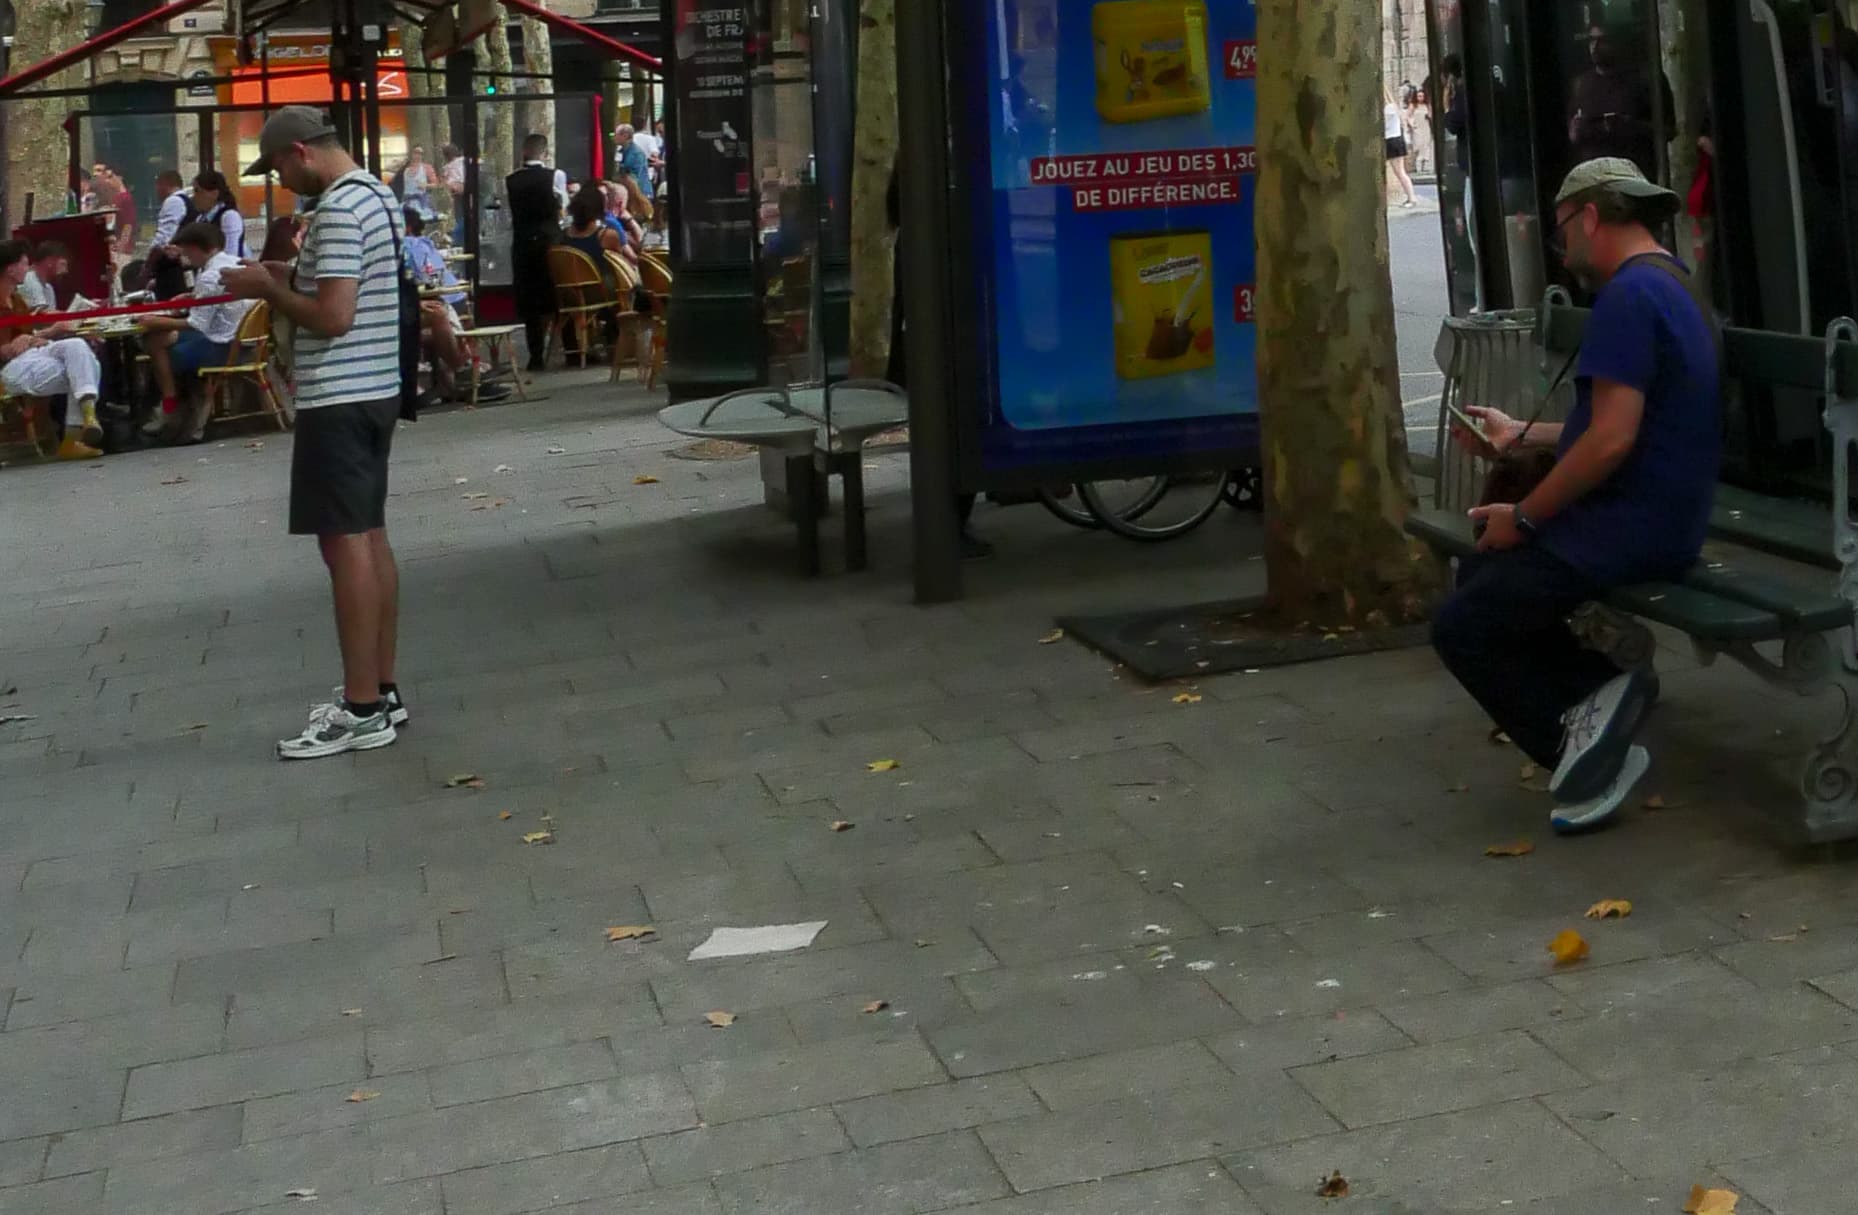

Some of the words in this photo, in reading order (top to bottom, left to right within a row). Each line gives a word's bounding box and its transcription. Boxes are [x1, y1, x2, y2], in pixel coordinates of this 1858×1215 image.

[1033, 160, 1098, 181] JOUEZ
[1102, 157, 1130, 177] AU
[1135, 155, 1172, 175] JEU
[1177, 153, 1217, 173] DES
[1075, 188, 1102, 208] DE
[1107, 181, 1238, 205] DIFFÉRENCE.
